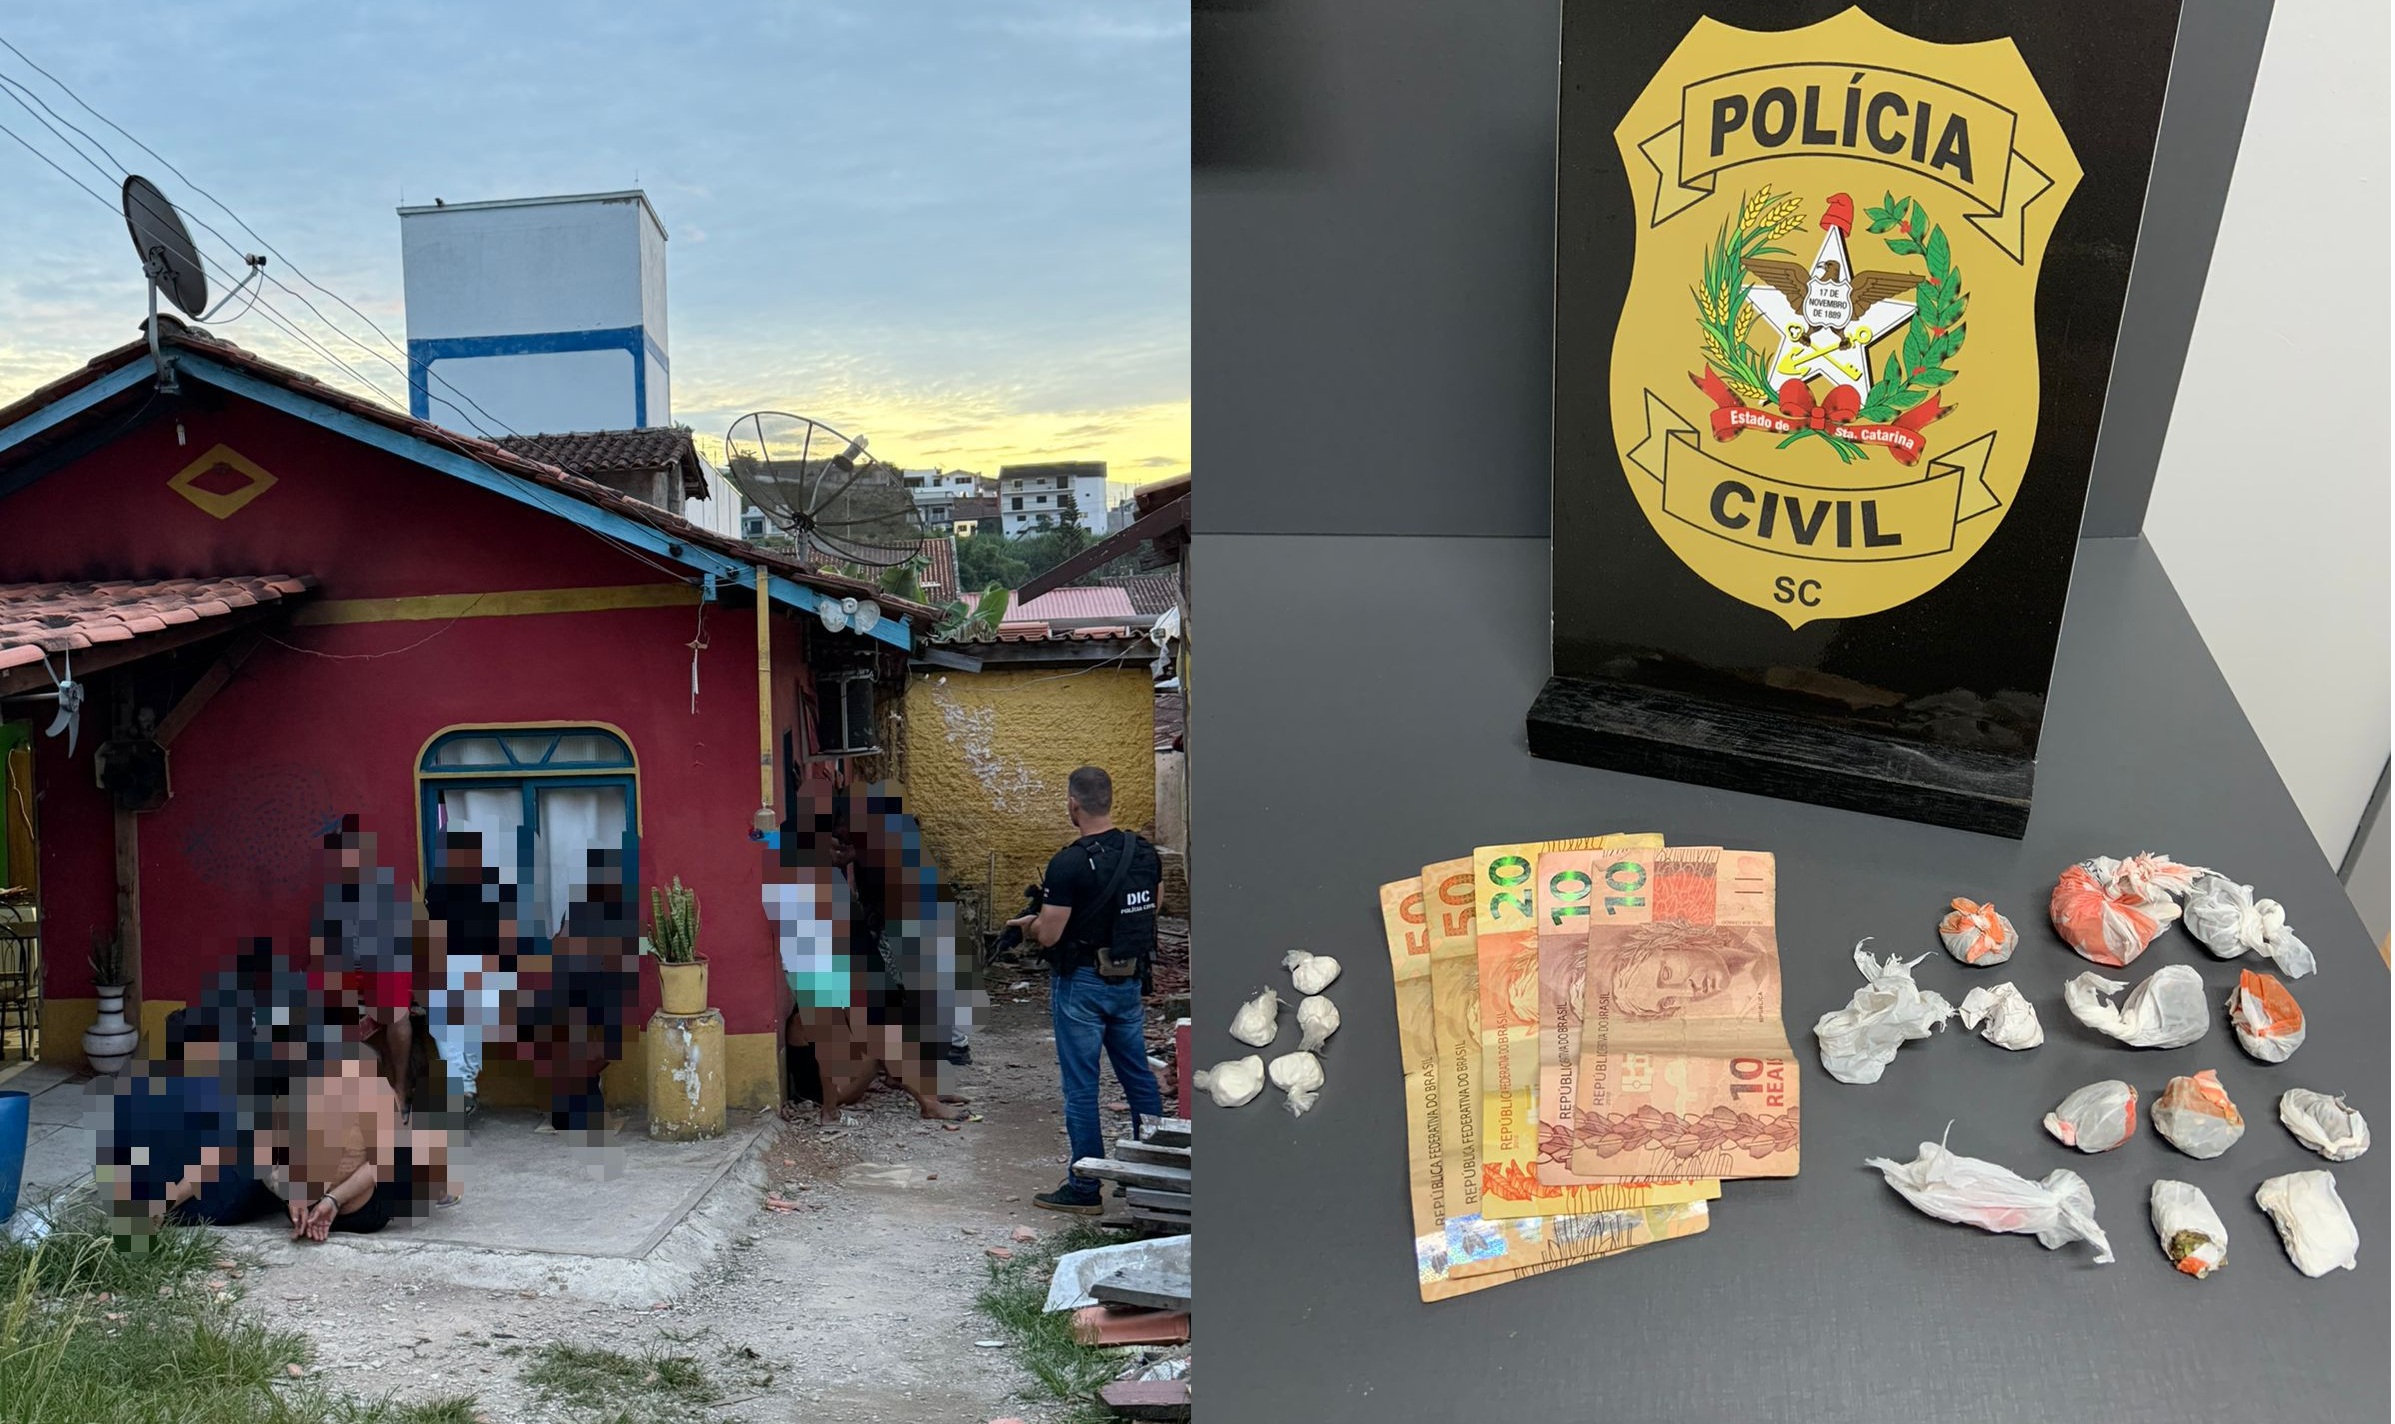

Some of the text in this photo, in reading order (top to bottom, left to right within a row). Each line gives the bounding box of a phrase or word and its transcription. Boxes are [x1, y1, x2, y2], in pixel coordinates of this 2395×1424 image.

[1709, 71, 1975, 185] POLÍCIA
[1809, 298, 1848, 309] NOVEMBRO
[1820, 288, 1839, 298] 17 DE
[1813, 309, 1842, 320] DE 1889
[1730, 410, 1790, 432] Estado de
[1834, 426, 1915, 450] Sta. Catarina
[1709, 480, 1902, 549] CIVIL
[1772, 575, 1822, 607] SC
[1127, 890, 1150, 905] DIC
[1438, 873, 1477, 938] 50
[1488, 855, 1534, 921] 20
[1549, 870, 1593, 926] 10
[1604, 861, 1647, 916] 10
[1497, 1010, 1508, 1044] BRASIL
[1557, 1001, 1568, 1033] BRASIL
[1422, 1056, 1436, 1092] BRASIL
[1729, 1058, 1764, 1101] 10
[1426, 1093, 1438, 1108] DO
[1426, 1109, 1441, 1159] FEDERATIVA
[1456, 1040, 1477, 1205] REPÚBLICA FEDERATIVA DO BRASIL
